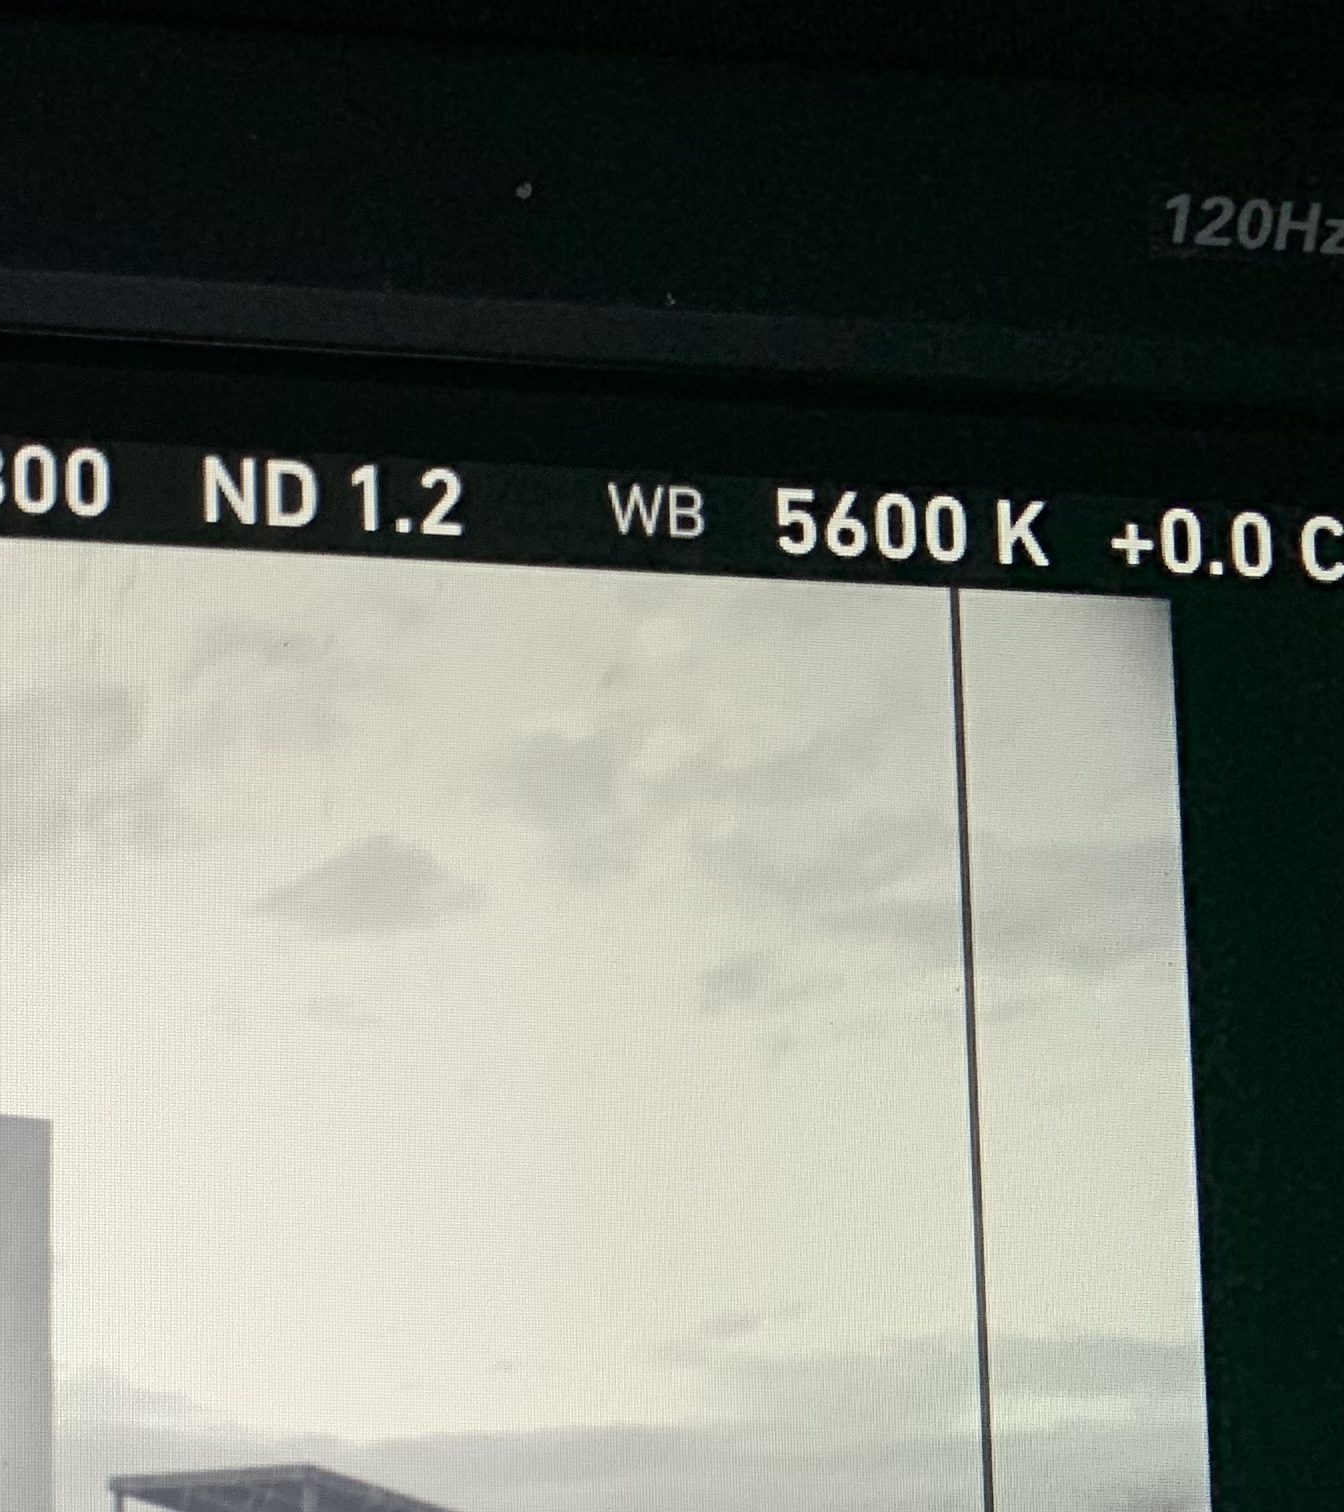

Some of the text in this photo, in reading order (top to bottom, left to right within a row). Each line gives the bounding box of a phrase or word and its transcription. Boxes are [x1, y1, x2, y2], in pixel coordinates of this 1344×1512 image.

[204, 455, 463, 536] ND 1.2
[607, 482, 705, 538] WB
[776, 487, 967, 563] 5600
[996, 499, 1050, 567] K
[1111, 507, 1273, 578] +0.0
